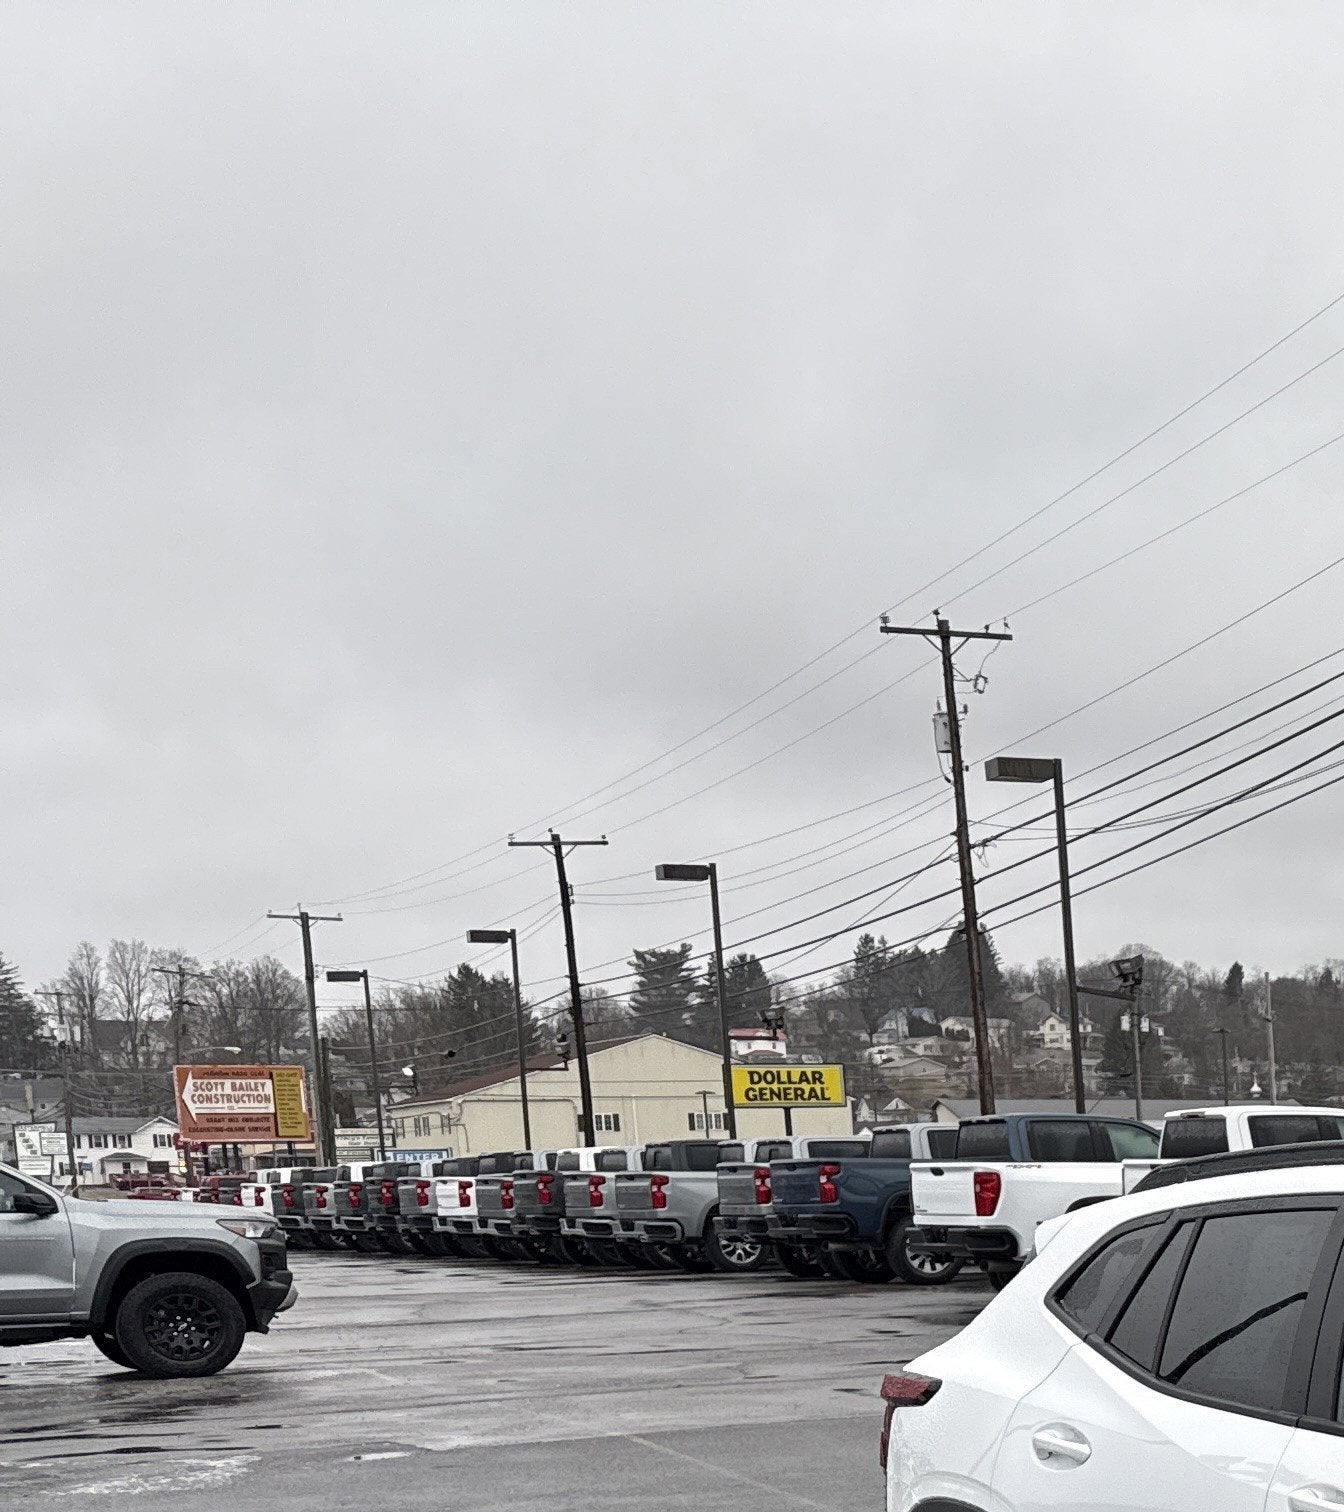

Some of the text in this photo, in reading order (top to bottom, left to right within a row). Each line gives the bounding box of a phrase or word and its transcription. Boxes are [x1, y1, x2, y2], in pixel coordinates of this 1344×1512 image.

[747, 1070, 825, 1085] DOLLAR
[192, 1081, 267, 1093] SCOTT BAILEY
[190, 1093, 272, 1105] CONSTRUCTION
[744, 1087, 831, 1101] GENERAL
